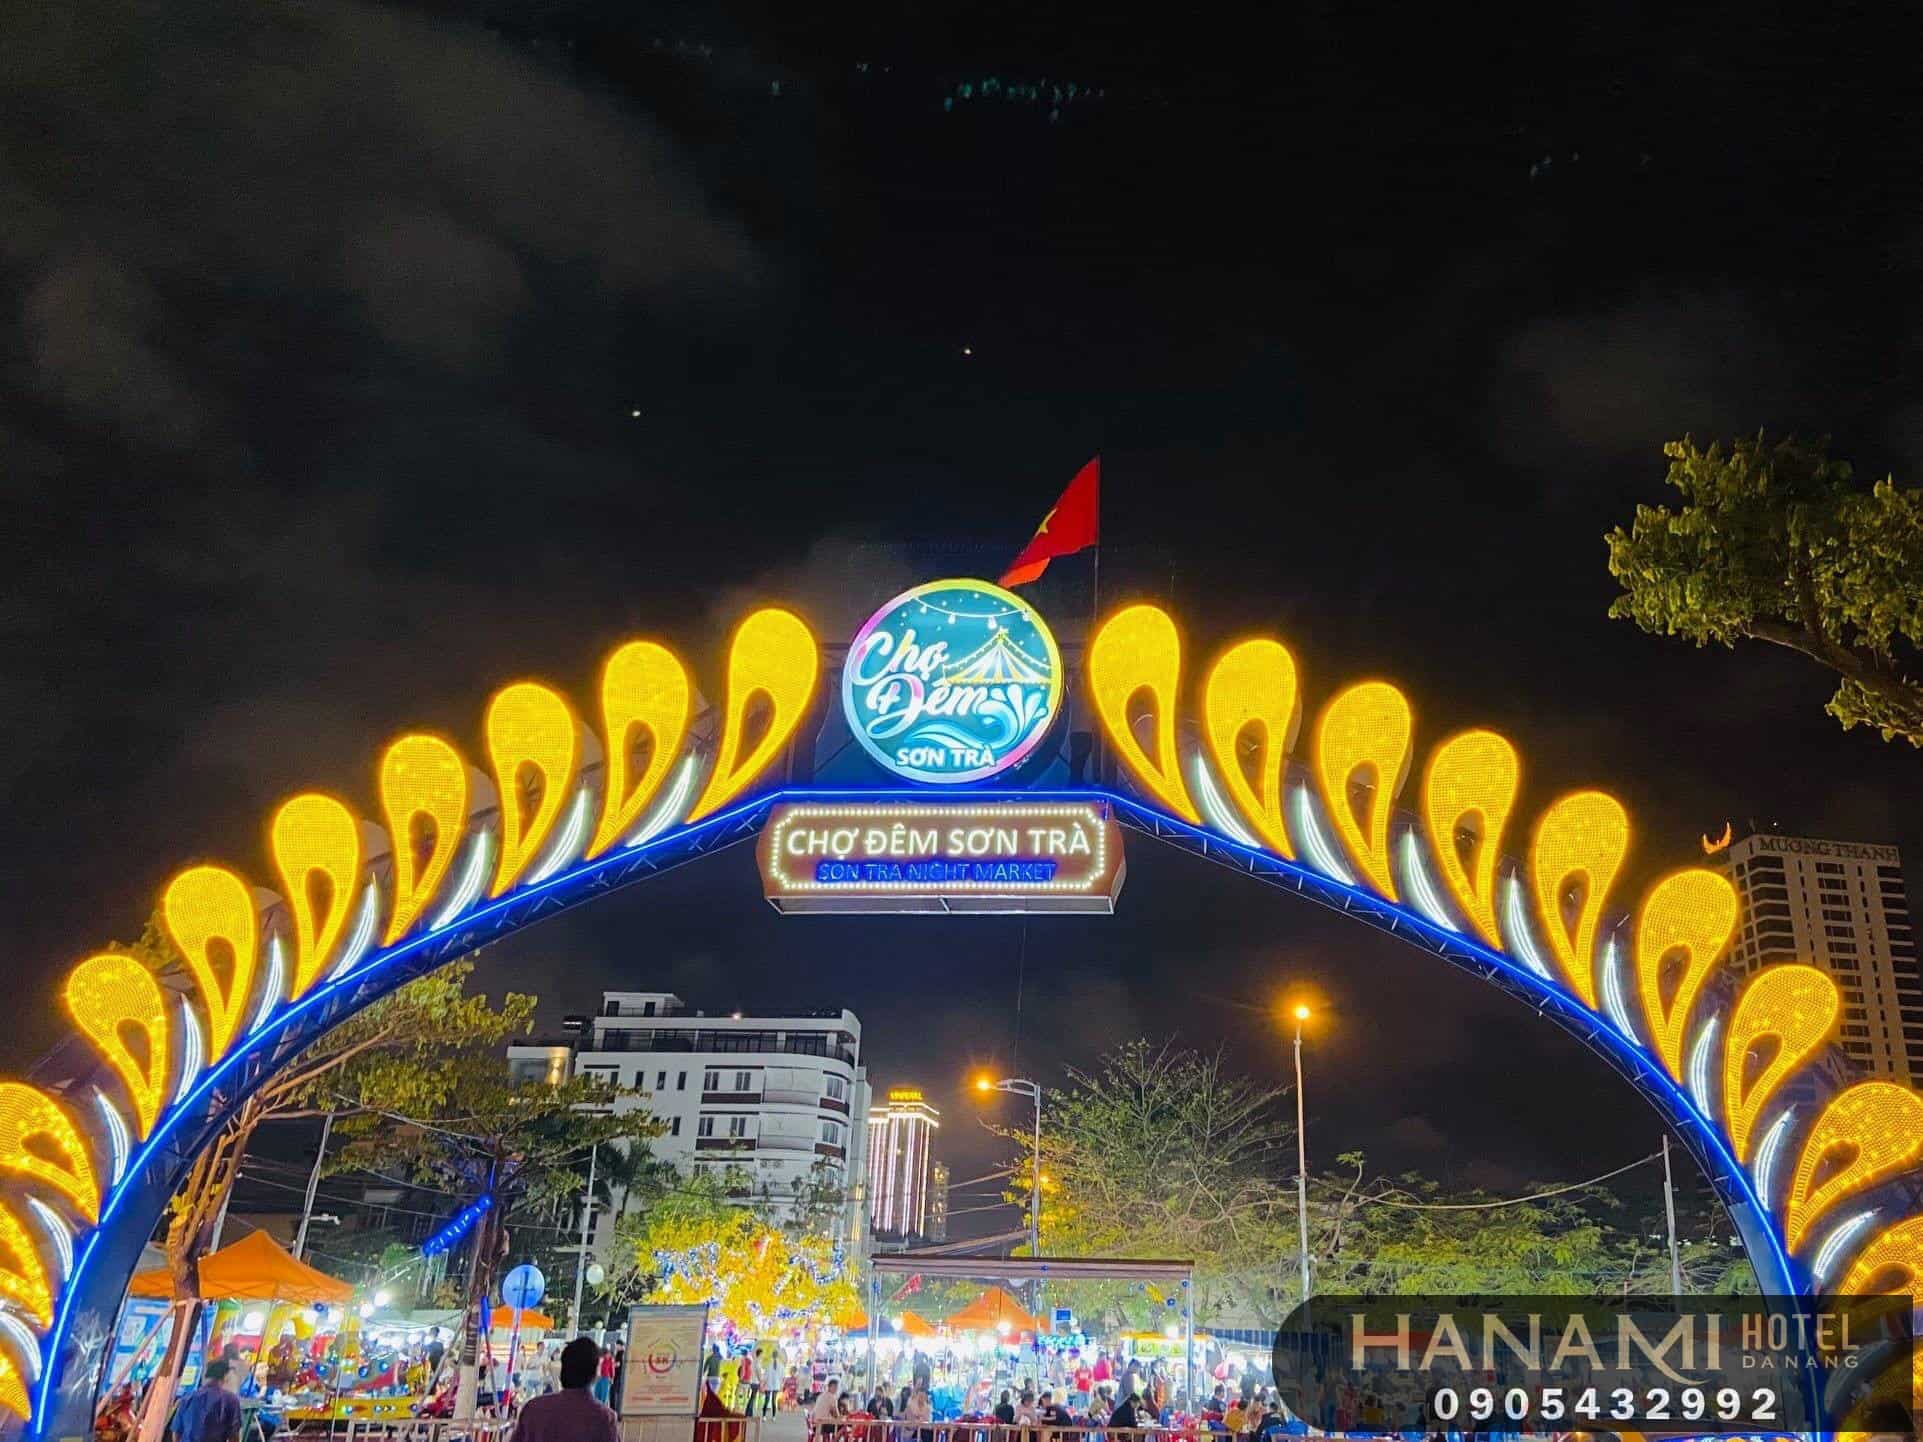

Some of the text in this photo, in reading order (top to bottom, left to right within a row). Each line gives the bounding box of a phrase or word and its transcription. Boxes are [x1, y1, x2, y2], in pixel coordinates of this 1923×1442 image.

[850, 629, 949, 686] Chợ
[896, 747, 945, 766] SƠN
[951, 743, 995, 767] TRÀ
[787, 821, 1091, 860] CHỢ ĐÊM SƠN TRÀ
[908, 863, 970, 881] NIGHT
[975, 863, 1056, 881] MARKET
